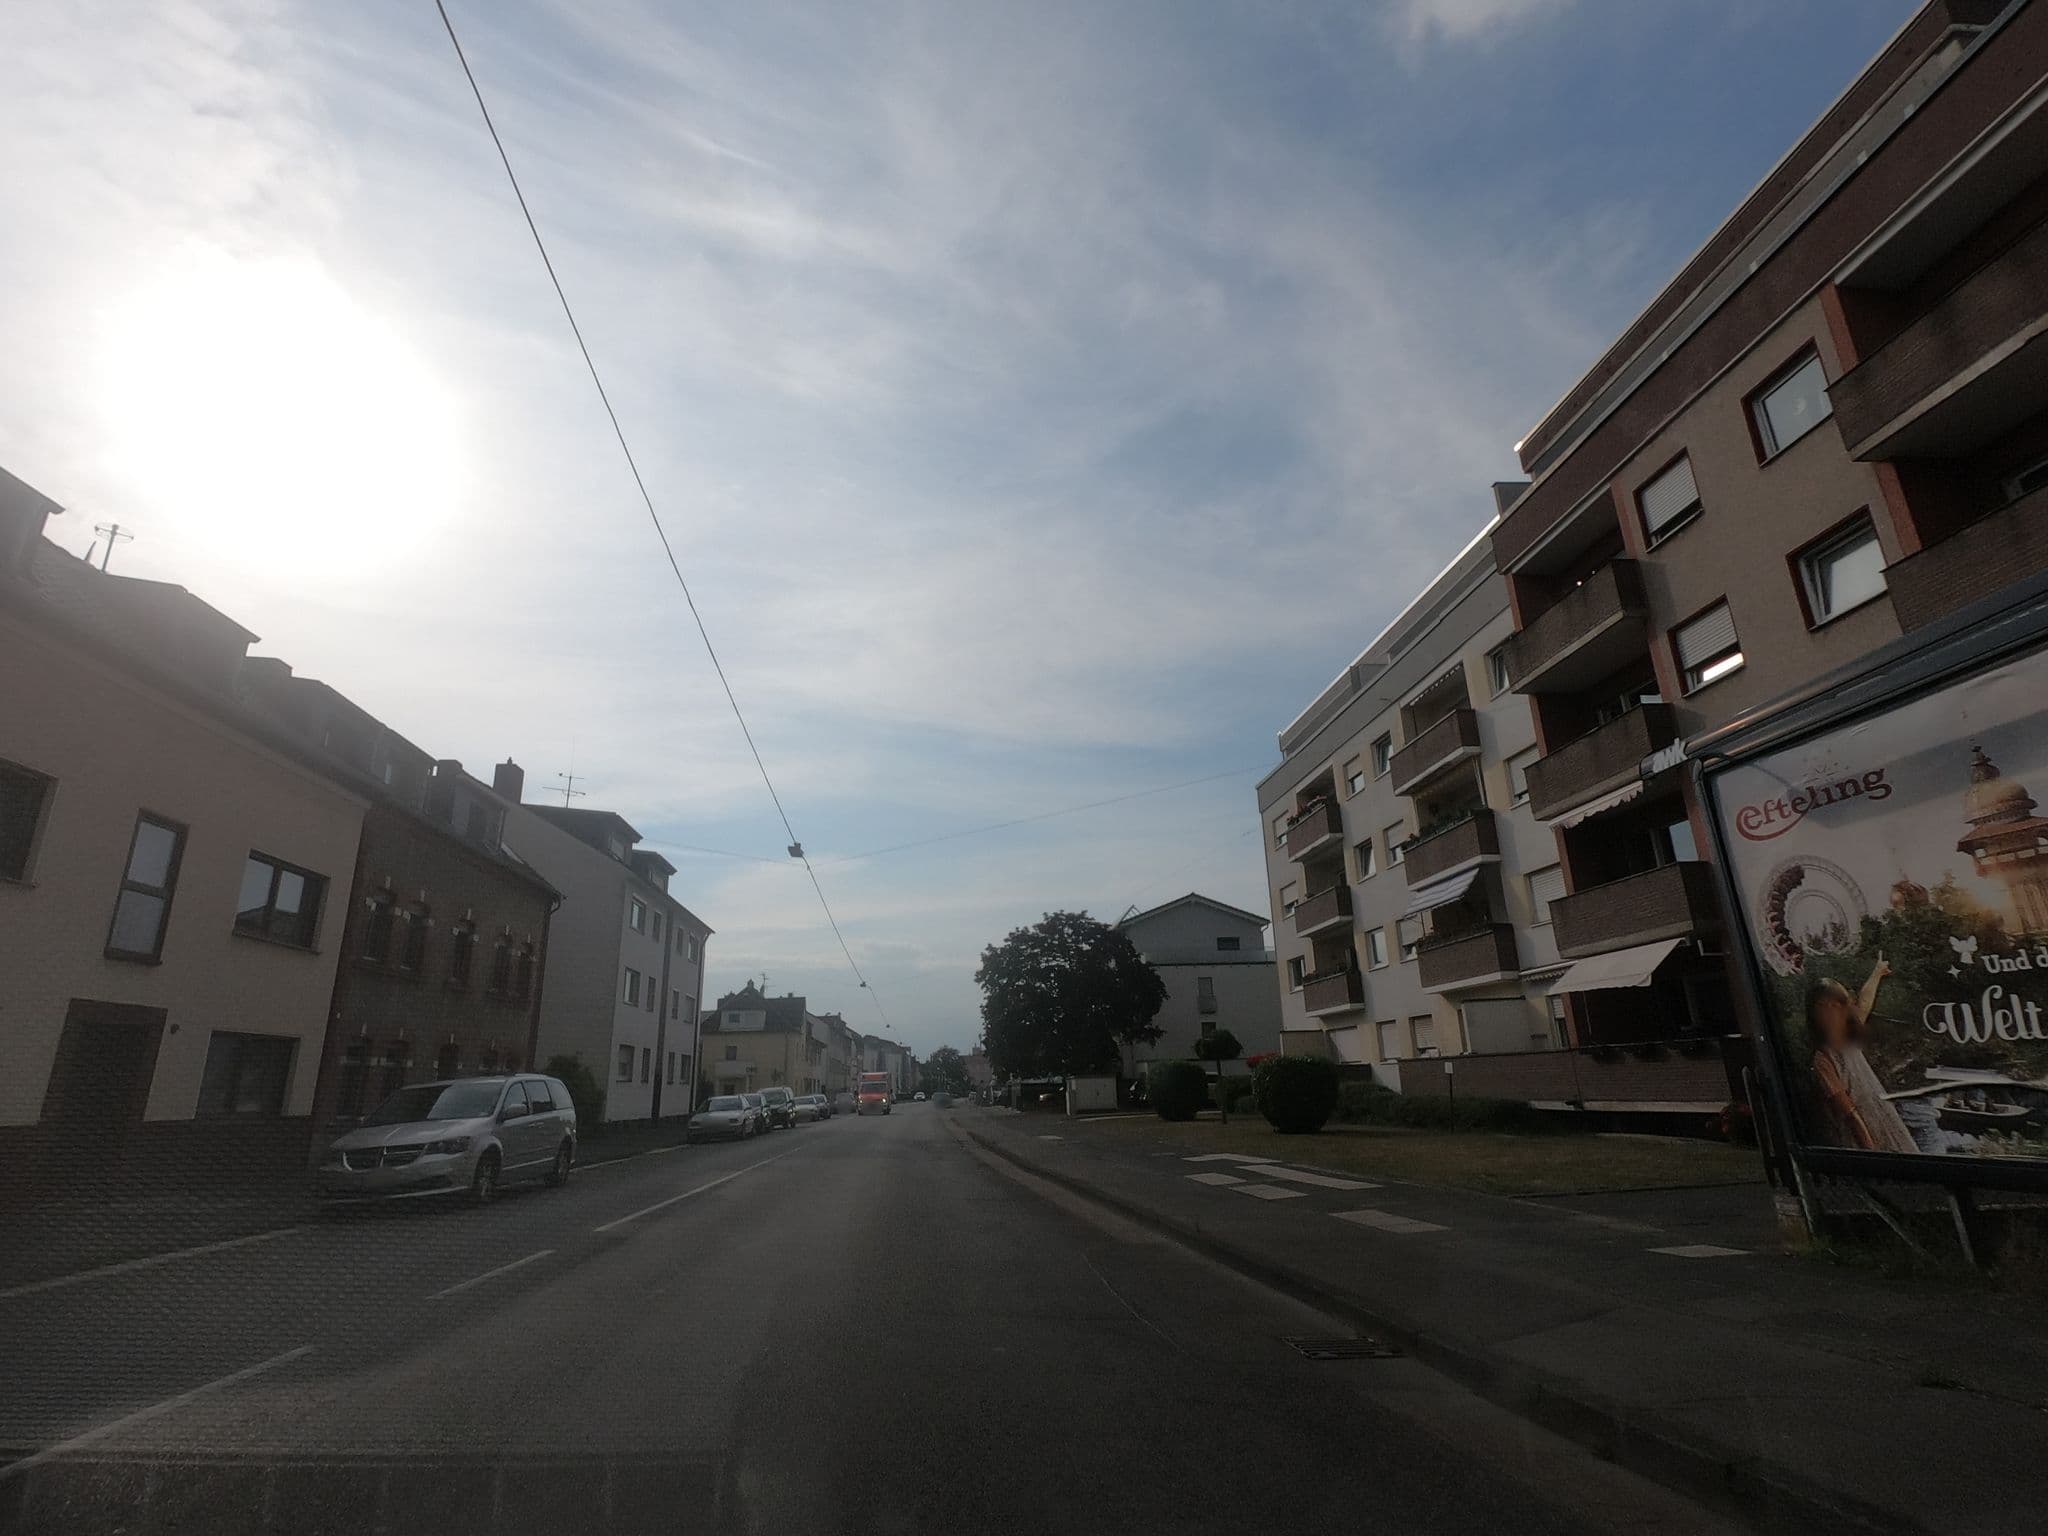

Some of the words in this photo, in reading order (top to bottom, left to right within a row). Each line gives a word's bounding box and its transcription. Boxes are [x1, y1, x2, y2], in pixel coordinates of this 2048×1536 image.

[1736, 768, 1892, 841] efteling
[1980, 948, 2033, 974] Und
[1923, 984, 2048, 1044] Welt
